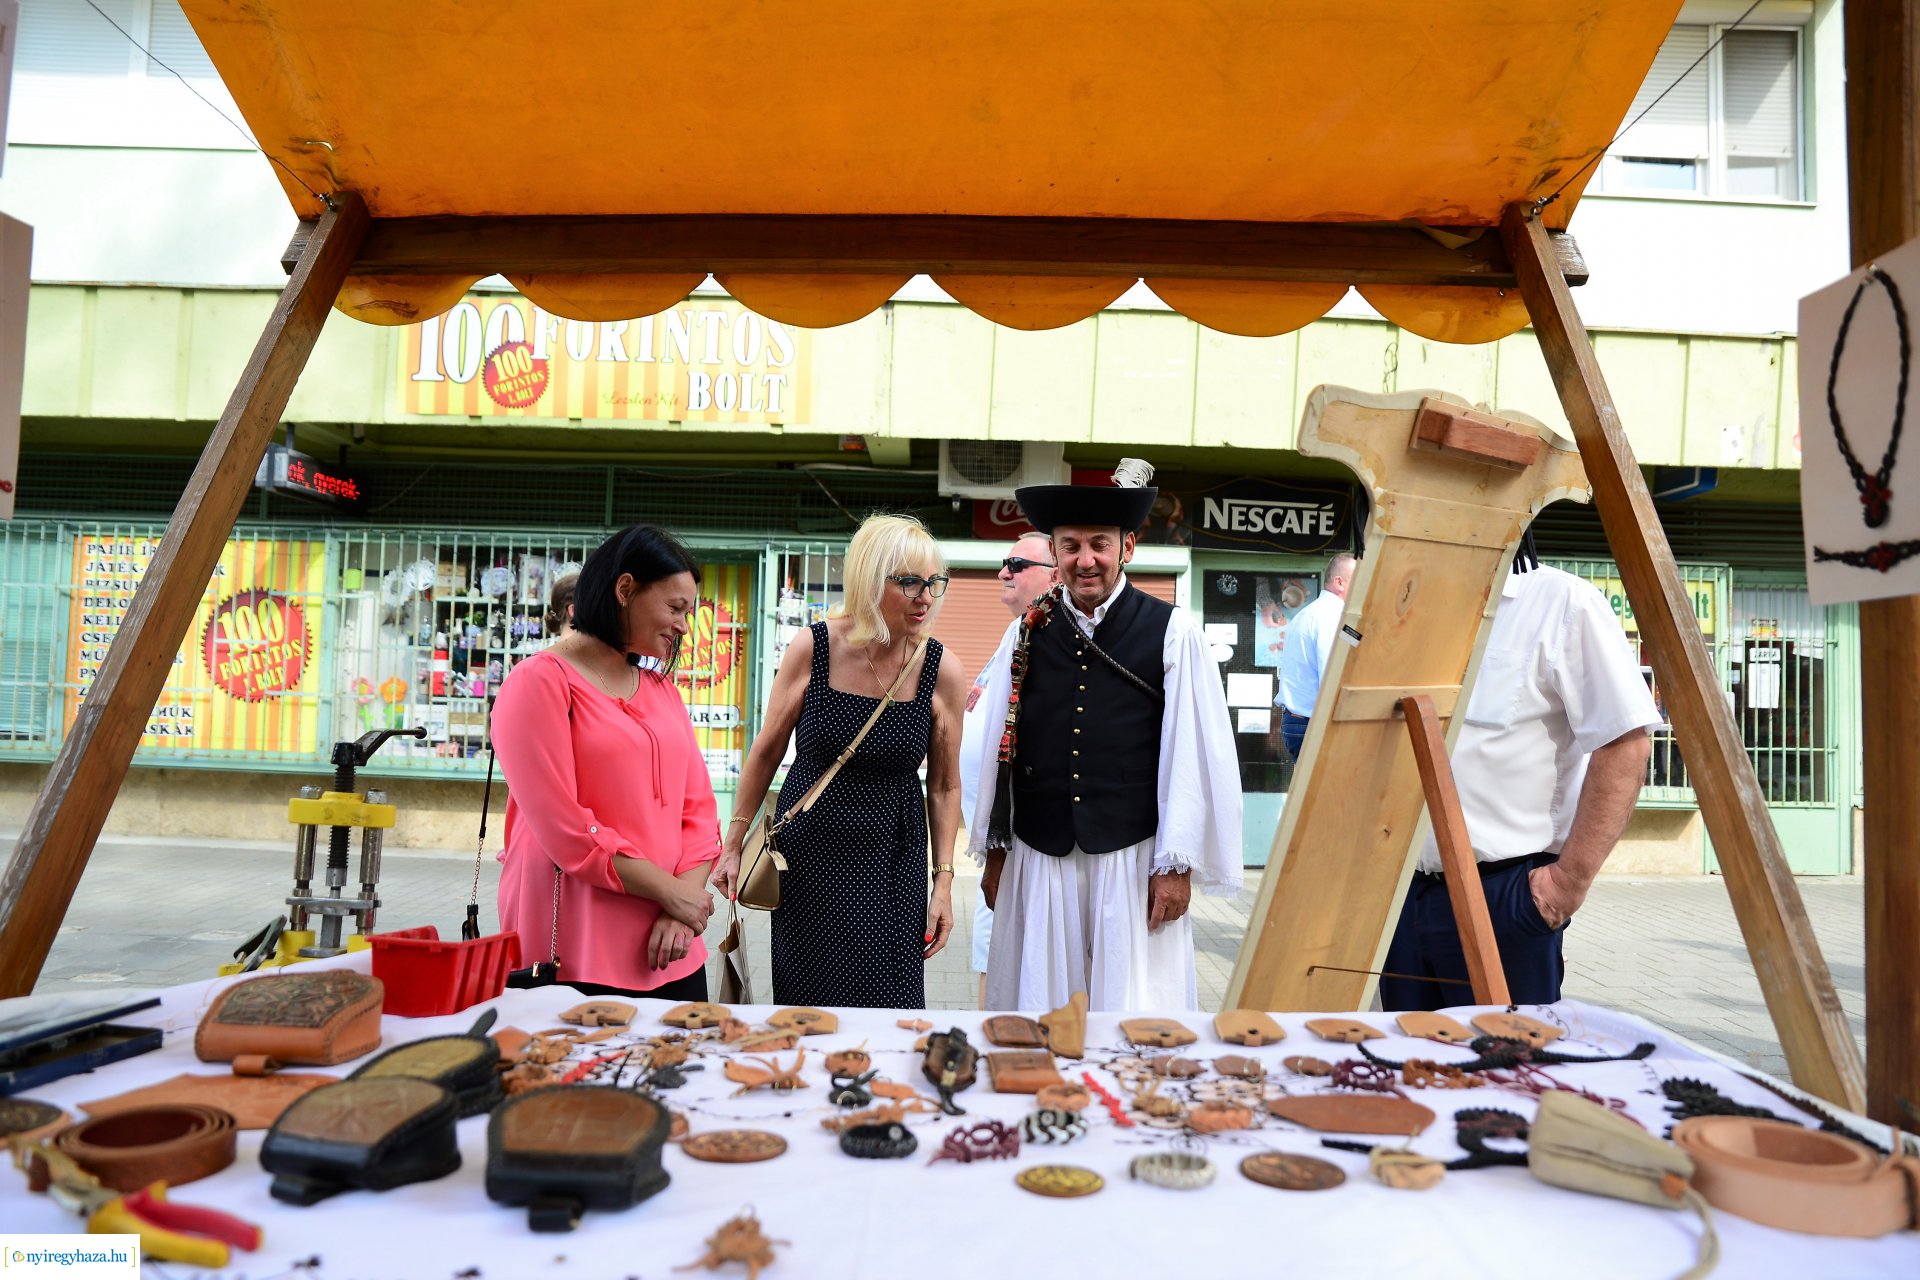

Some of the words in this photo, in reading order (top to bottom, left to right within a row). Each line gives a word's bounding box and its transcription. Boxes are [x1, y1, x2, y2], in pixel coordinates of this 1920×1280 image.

[530, 306, 797, 368] FORINTOS
[491, 345, 533, 382] 100
[492, 369, 545, 397] FORINTOS
[686, 370, 788, 413] BOLT
[1203, 497, 1335, 536] NESCAFÉ
[217, 598, 285, 656] 100
[219, 638, 304, 681] FORINTOS
